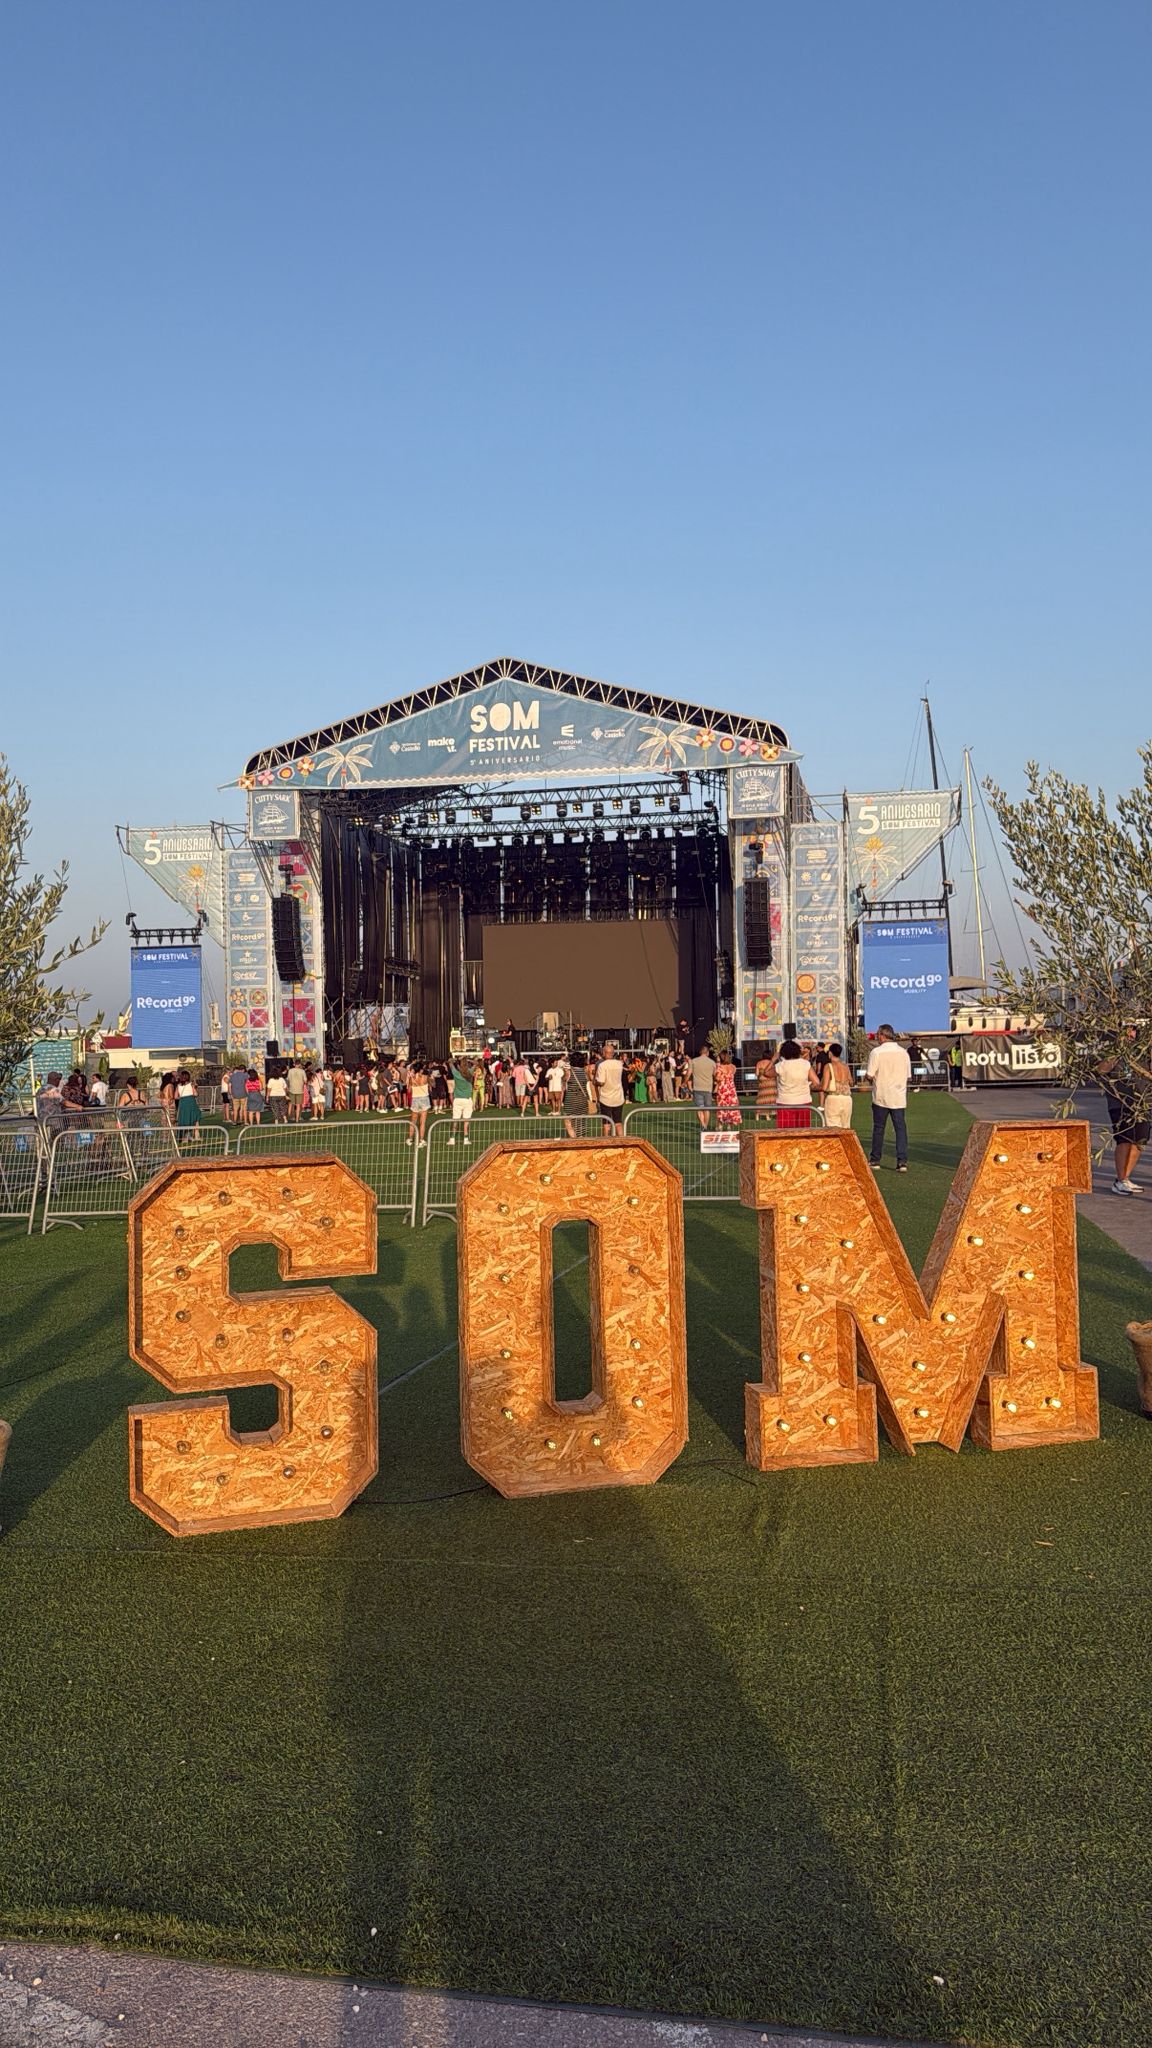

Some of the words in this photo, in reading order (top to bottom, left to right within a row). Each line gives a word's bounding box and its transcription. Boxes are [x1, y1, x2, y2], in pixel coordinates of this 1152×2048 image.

[470, 700, 540, 733] SOM
[427, 737, 455, 747] make
[469, 735, 541, 753] FESTIVAL
[478, 755, 541, 765] ANIVERSARIO
[735, 769, 757, 780] CUTTY
[757, 768, 778, 778] SARK
[254, 793, 273, 804] CUTTY
[273, 793, 291, 803] SARK
[857, 805, 880, 835] 5
[902, 819, 939, 828] FESTIVAL
[143, 839, 161, 865] 5
[179, 852, 211, 860] FESTIVAL
[877, 929, 894, 937] SOM
[896, 927, 933, 936] FESTIVAL
[158, 952, 189, 960] FESTIVAL
[128, 1119, 1101, 1538] SOM
